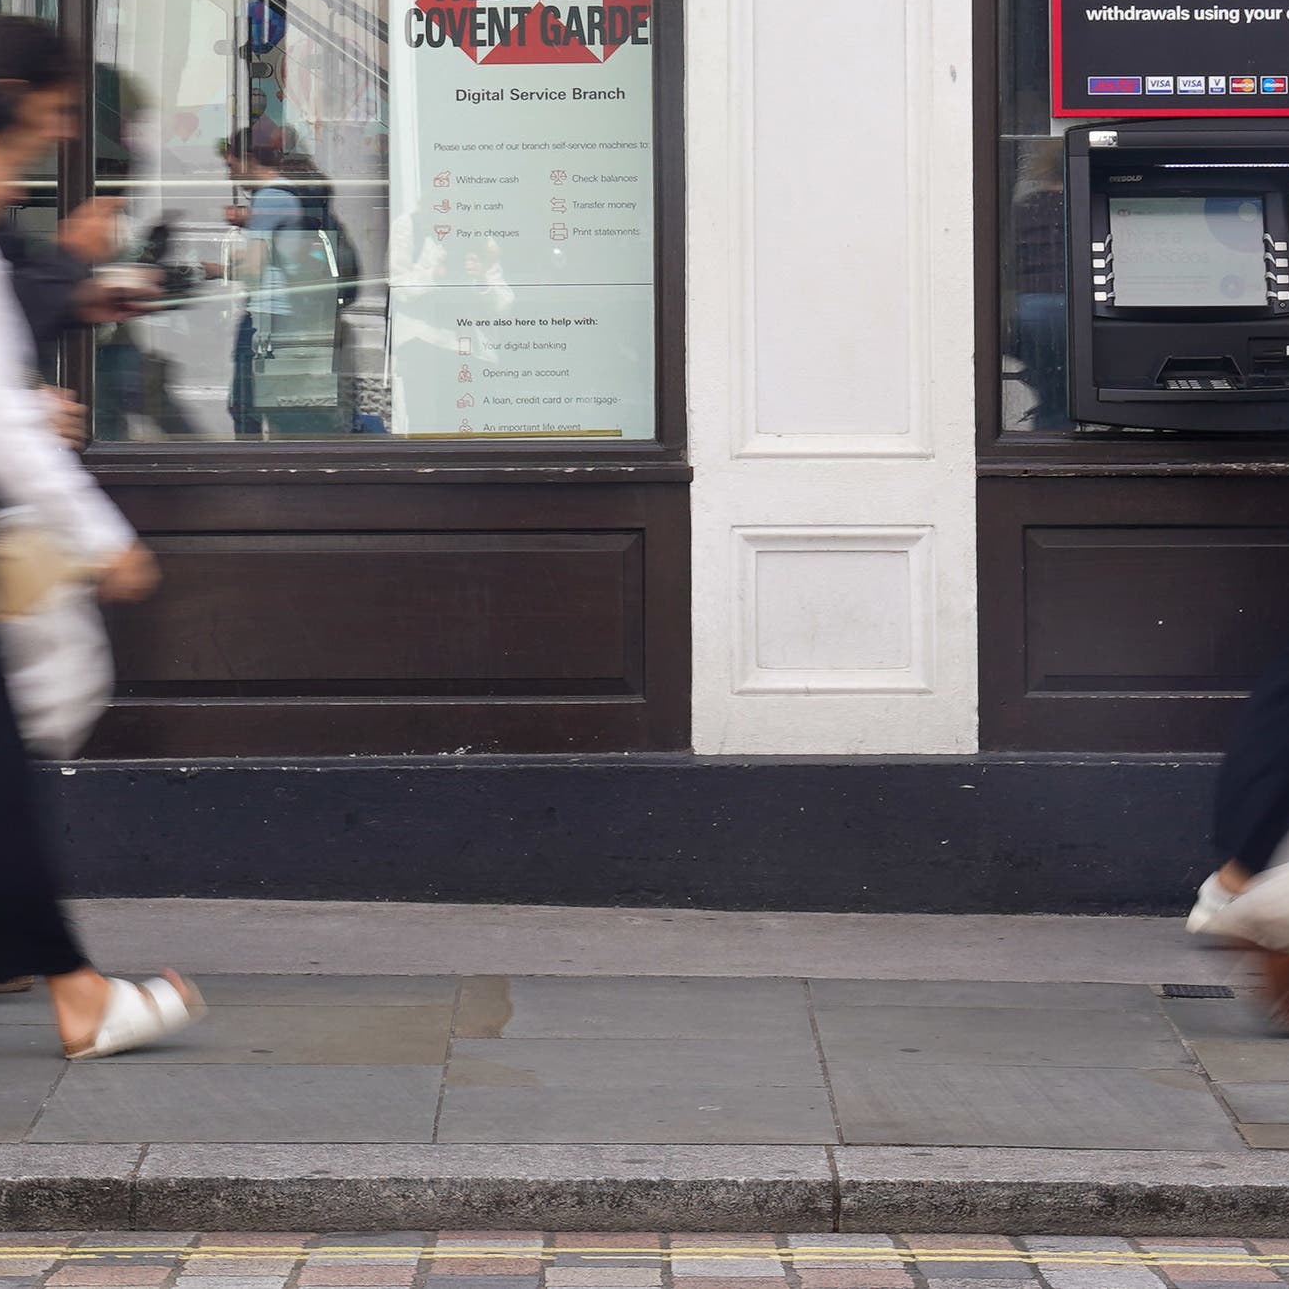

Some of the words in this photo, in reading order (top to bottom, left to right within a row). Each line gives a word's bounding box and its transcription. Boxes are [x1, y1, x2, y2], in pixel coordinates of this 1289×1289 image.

[1086, 6, 1190, 22] withdrawals
[1194, 6, 1240, 25] using
[1244, 8, 1282, 24] your
[404, 6, 531, 48] COVENT
[540, 4, 652, 48] GARDE
[1150, 79, 1171, 87] VISA
[1181, 79, 1202, 87] VISA
[455, 88, 504, 104] Digital
[510, 88, 567, 101] Service
[572, 87, 626, 101] Branch
[433, 143, 460, 151] Please
[477, 143, 493, 151] one
[495, 142, 505, 151] of
[506, 143, 519, 151] our
[521, 142, 550, 150] branch
[599, 141, 637, 149] machines
[455, 175, 497, 184] Withdraw
[499, 175, 519, 183] cash
[572, 175, 599, 183] Check
[601, 174, 638, 182] balances
[456, 202, 471, 212] Pay
[474, 202, 482, 210] in
[483, 202, 503, 210] cash
[572, 201, 605, 209] Transfer
[607, 201, 637, 211] money
[456, 229, 471, 239] Pay
[474, 229, 482, 237] in
[483, 229, 519, 238] cheques
[573, 228, 592, 236] Print
[594, 228, 640, 236] statements
[493, 318, 512, 326] also
[515, 318, 536, 326] here
[551, 317, 572, 327] help
[574, 317, 598, 325] with:
[504, 341, 531, 351] digital
[533, 341, 567, 351] banking
[483, 369, 519, 378] Opening
[535, 369, 569, 377] account
[483, 396, 490, 404] A
[516, 396, 540, 404] credit
[542, 396, 561, 404] card
[483, 423, 495, 431] An
[498, 423, 540, 432] important
[542, 423, 555, 431] life
